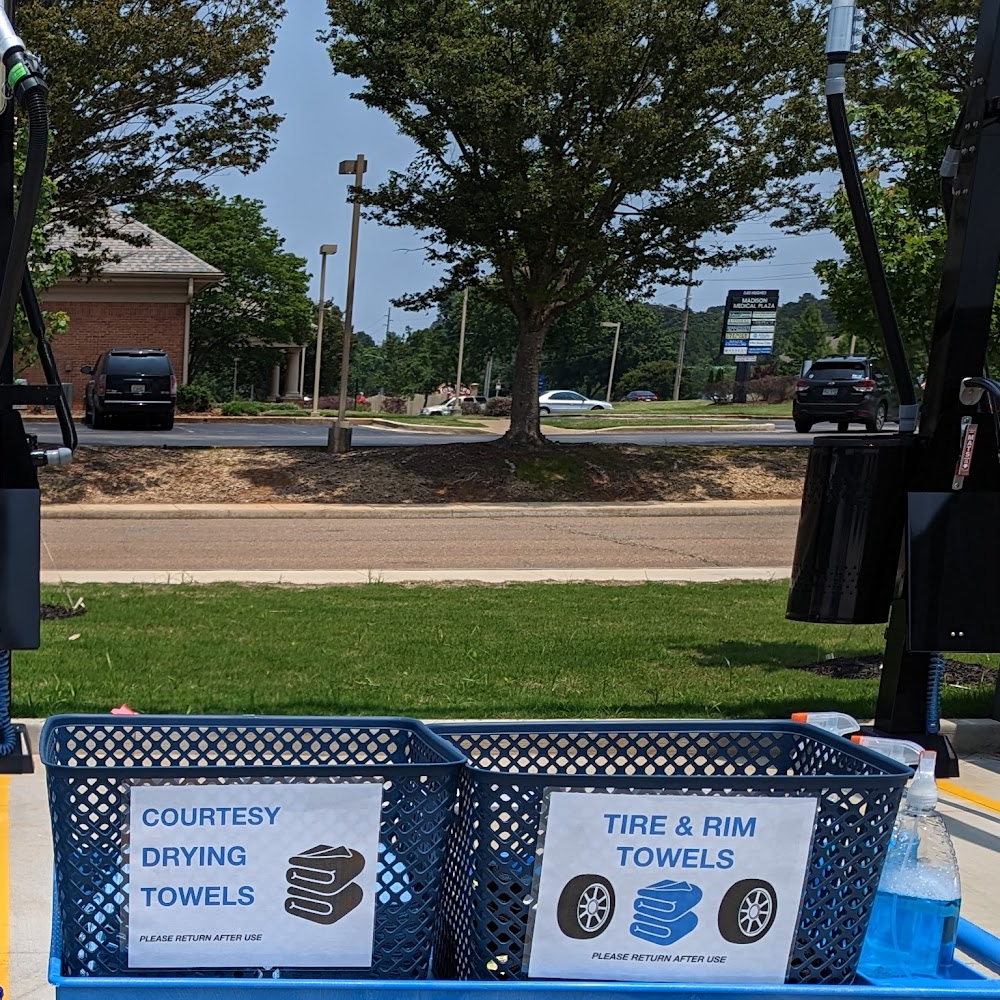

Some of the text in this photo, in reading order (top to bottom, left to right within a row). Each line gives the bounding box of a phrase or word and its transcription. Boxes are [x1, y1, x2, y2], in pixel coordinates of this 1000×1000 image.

[142, 806, 281, 827] COURTESY
[603, 813, 757, 837] TIRE & RIM
[142, 846, 247, 867] DRYING
[616, 846, 735, 869] TOWELS
[140, 886, 255, 907] TOWELS
[175, 934, 212, 942] RETURN
[213, 934, 243, 942] AFTER
[244, 933, 263, 941] USE
[591, 952, 728, 964] PLEASE RETURN AFTER USE
